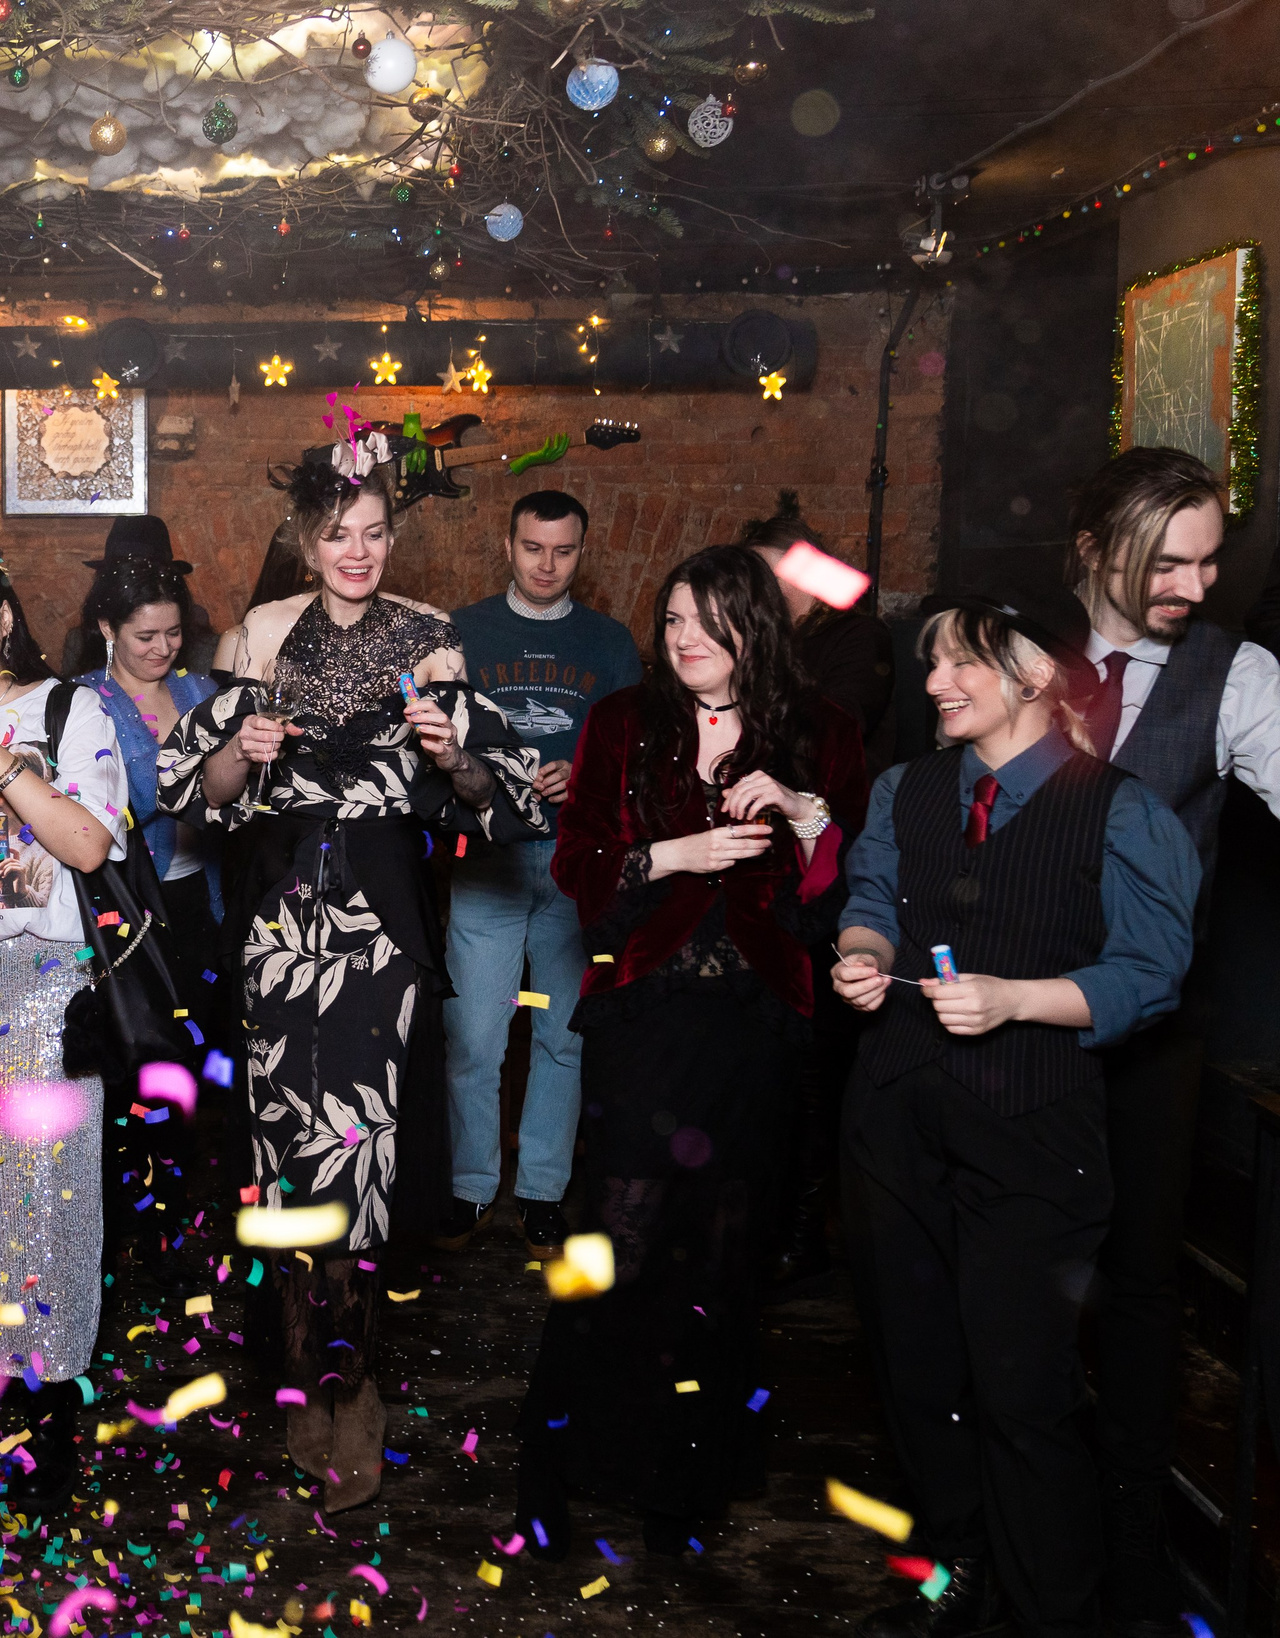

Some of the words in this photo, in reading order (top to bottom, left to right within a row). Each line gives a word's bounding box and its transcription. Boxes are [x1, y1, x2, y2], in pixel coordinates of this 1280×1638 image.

[480, 661, 597, 695] FREEDOM
[497, 685, 542, 693] PERFOMANCE
[545, 687, 578, 696] HERITAGE
